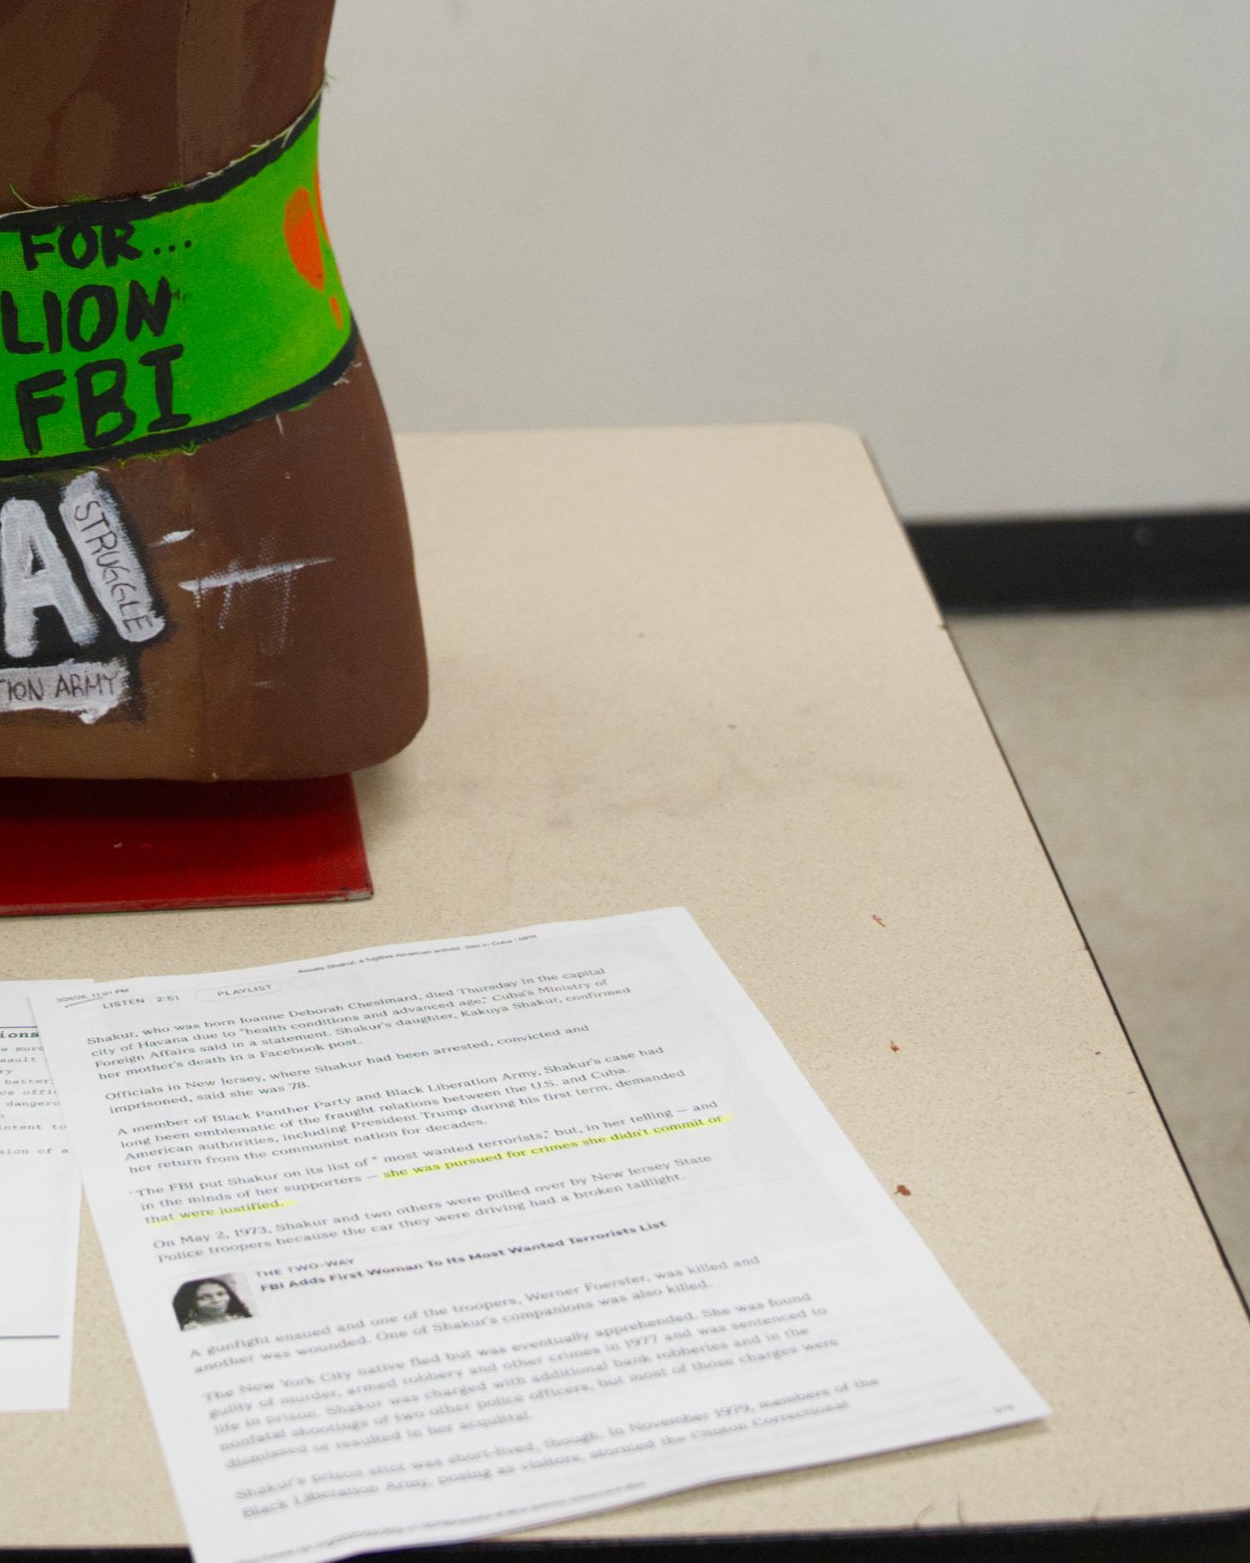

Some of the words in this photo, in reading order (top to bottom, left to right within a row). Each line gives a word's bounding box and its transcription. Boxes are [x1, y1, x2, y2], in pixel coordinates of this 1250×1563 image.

[20, 222, 193, 272] FOR...
[16, 343, 193, 456] FBI
[74, 499, 152, 635] STRUGGLE
[54, 669, 119, 698] ARMY
[86, 1031, 140, 1045] Shakur,
[141, 1026, 171, 1036] who
[173, 1023, 202, 1033] was
[203, 1019, 236, 1028] born
[239, 1013, 285, 1025] Joanne
[288, 1004, 345, 1019] Deborah
[348, 993, 423, 1009] Chesimard,
[425, 989, 455, 999] died
[456, 980, 518, 995] Thursday
[536, 974, 559, 983] the
[561, 967, 607, 981] capital
[216, 984, 272, 998] PLAYLIST
[104, 1086, 165, 1100] Officials
[166, 1083, 182, 1092] in
[184, 1080, 216, 1090] New
[220, 1075, 267, 1087] Jersey,
[268, 1069, 311, 1080] where
[313, 1060, 363, 1074] Shakur
[365, 1053, 393, 1065] had
[394, 1050, 430, 1060] been
[432, 1039, 495, 1055] arrested,
[496, 1028, 562, 1045] convicted
[564, 1024, 590, 1035] and
[109, 1094, 194, 1114] imprisoned,
[195, 1090, 226, 1101] said
[229, 1089, 254, 1098] she
[257, 1085, 286, 1095] was
[287, 1080, 311, 1091] 78.
[117, 1128, 128, 1136] A
[131, 1118, 190, 1134] member
[193, 1115, 208, 1124] of
[211, 1111, 252, 1123] Black
[255, 1104, 310, 1119] Panther
[313, 1097, 352, 1110] Party
[355, 1091, 382, 1102] and
[384, 1085, 425, 1098] Black
[426, 1076, 498, 1093] Liberation
[502, 1069, 542, 1082] Army,
[543, 1057, 602, 1074] Shakur's
[604, 1052, 636, 1063] case
[637, 1046, 665, 1057] had
[144, 1212, 175, 1224] that
[178, 1209, 215, 1219] were
[218, 1198, 285, 1216] justified.
[259, 1281, 286, 1293] FBI
[288, 1276, 327, 1289] Adds
[328, 1270, 365, 1282] First
[365, 1263, 424, 1276] Woman
[425, 1259, 444, 1268] To
[445, 1256, 467, 1265] Its
[467, 1249, 506, 1261] Most
[506, 1239, 566, 1255] Wanted
[566, 1227, 638, 1245] Terrorists
[638, 1220, 667, 1232] List
